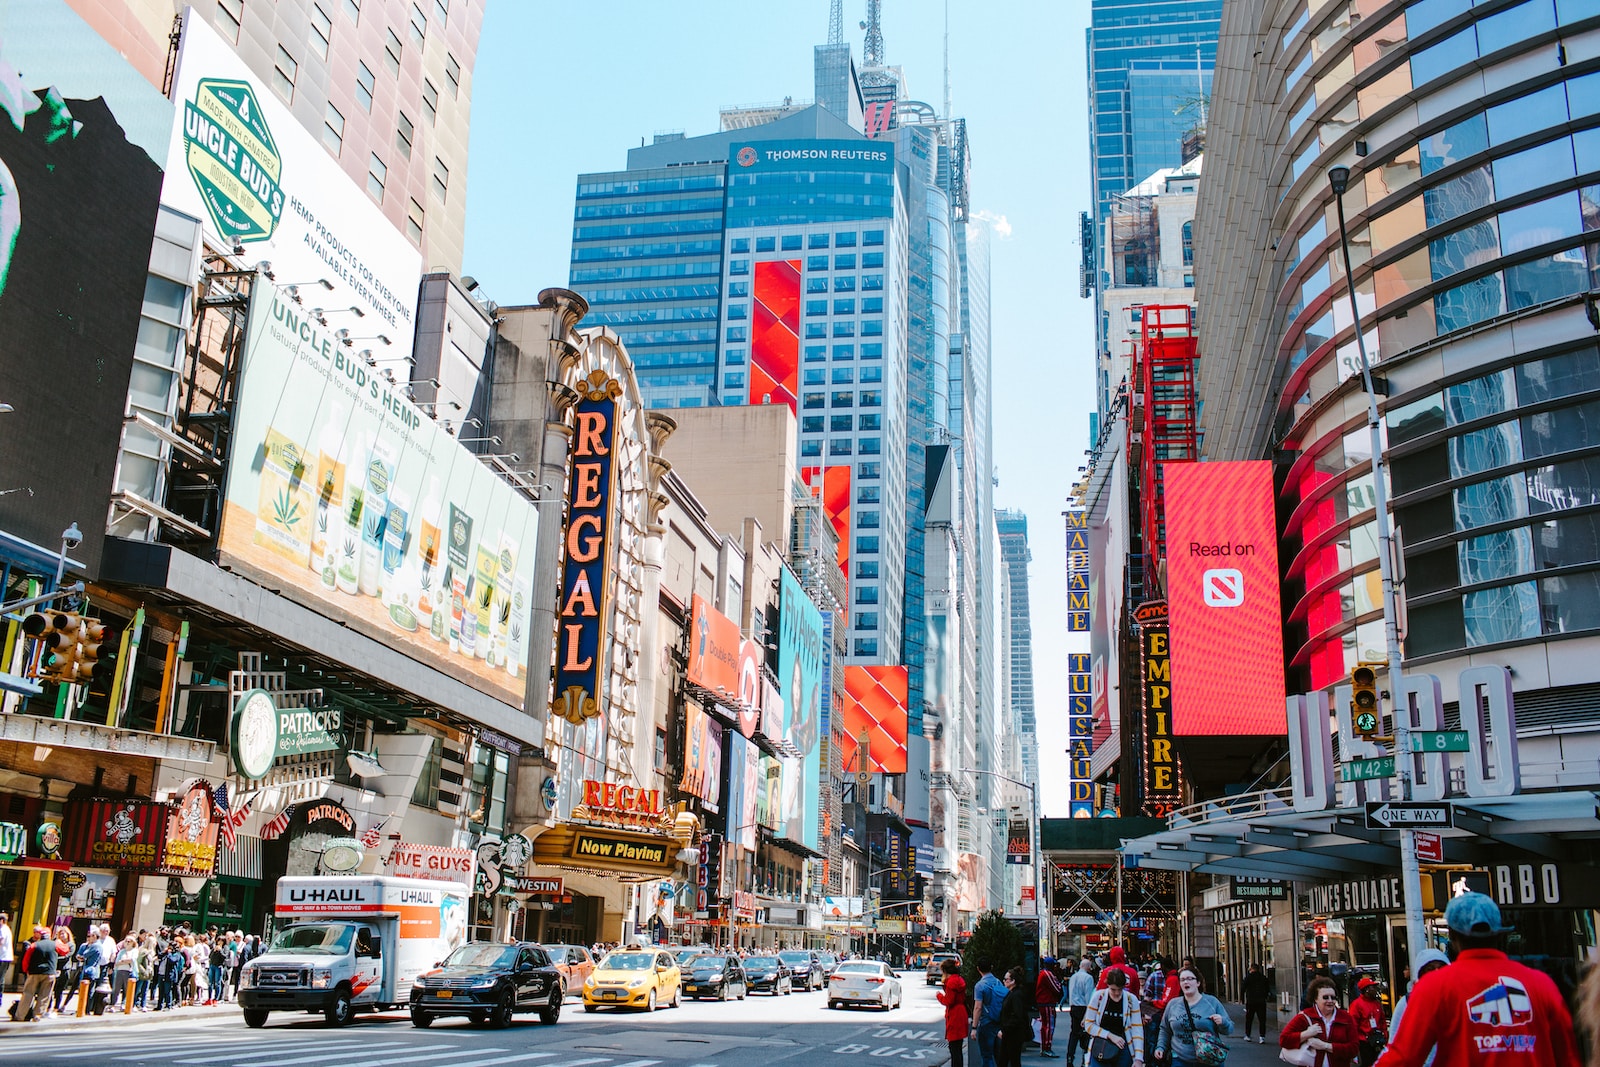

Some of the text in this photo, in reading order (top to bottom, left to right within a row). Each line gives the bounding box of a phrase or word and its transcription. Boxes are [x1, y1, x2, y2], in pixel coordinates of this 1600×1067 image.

[203, 95, 224, 120] MADE
[225, 116, 242, 139] WITH
[185, 106, 282, 217] UNCLE BUD'S
[766, 149, 887, 161] THOMSON REUTERS
[291, 195, 412, 324] HEMP PRODUCTS FOR EVERYONE,
[303, 232, 398, 329] AVAILABLE EVERYWHERE.
[270, 324, 300, 355] Natural
[300, 351, 333, 383] products
[334, 375, 345, 389] for
[345, 387, 364, 408] every
[364, 400, 378, 417] part
[272, 298, 420, 430] UNCLE BUD'S HEMP
[561, 412, 609, 673] REGAL
[1190, 541, 1255, 557] Read on
[1067, 511, 1088, 631] MADAME
[1138, 605, 1168, 619] amc
[785, 585, 821, 662] Fly Away
[710, 640, 738, 673] Double Play
[1148, 633, 1172, 790] EMPIRE
[281, 710, 341, 735] PATRICK'S
[1071, 653, 1091, 800] TUSSAUD
[1286, 664, 1521, 812] URBO
[1436, 734, 1465, 749] 8 AV
[1353, 763, 1363, 778] W
[1365, 761, 1381, 777] 42
[583, 779, 664, 815] REGAL
[307, 804, 353, 832] PATRICK'S
[590, 809, 659, 829] CINEMAS
[1154, 804, 1174, 819] 25
[1381, 810, 1440, 821] ONE WAY
[93, 841, 157, 856] CRUMBS
[580, 839, 663, 862] Now Playing
[1008, 845, 1029, 853] RISE
[1009, 837, 1028, 846] ALL
[126, 854, 154, 863] SHOP
[427, 854, 471, 873] GUYS
[515, 878, 559, 891] WESTIN
[1236, 886, 1270, 896] RESTAURANT
[290, 889, 365, 902] U-HAUL
[401, 890, 434, 904] U-HAUL
[1314, 878, 1400, 914] TIMES SQUARE
[1213, 900, 1270, 923] DOWNSTAIRS
[872, 1028, 942, 1042] ONL
[1474, 1035, 1536, 1048] TOPVIEW
[833, 1043, 937, 1060] BUS
